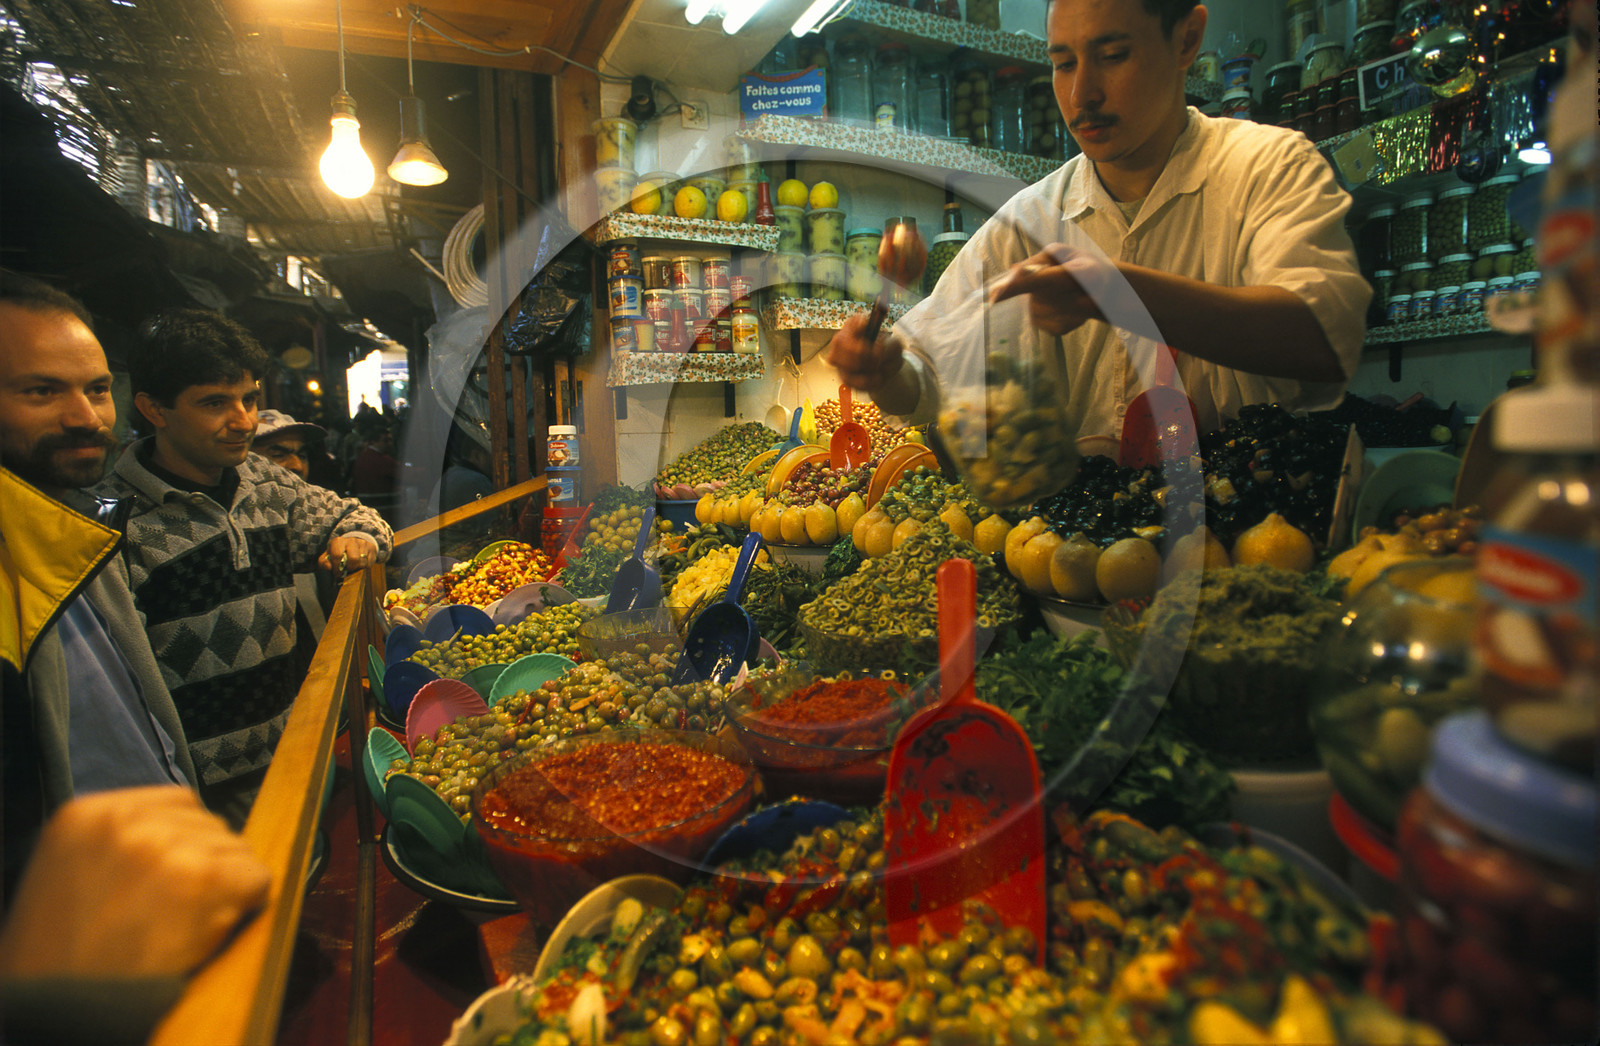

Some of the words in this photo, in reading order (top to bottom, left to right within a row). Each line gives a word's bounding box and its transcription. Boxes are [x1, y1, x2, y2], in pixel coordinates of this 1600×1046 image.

[746, 85, 778, 96] Faites
[780, 84, 821, 94] comme
[752, 97, 811, 110] chez-vous
